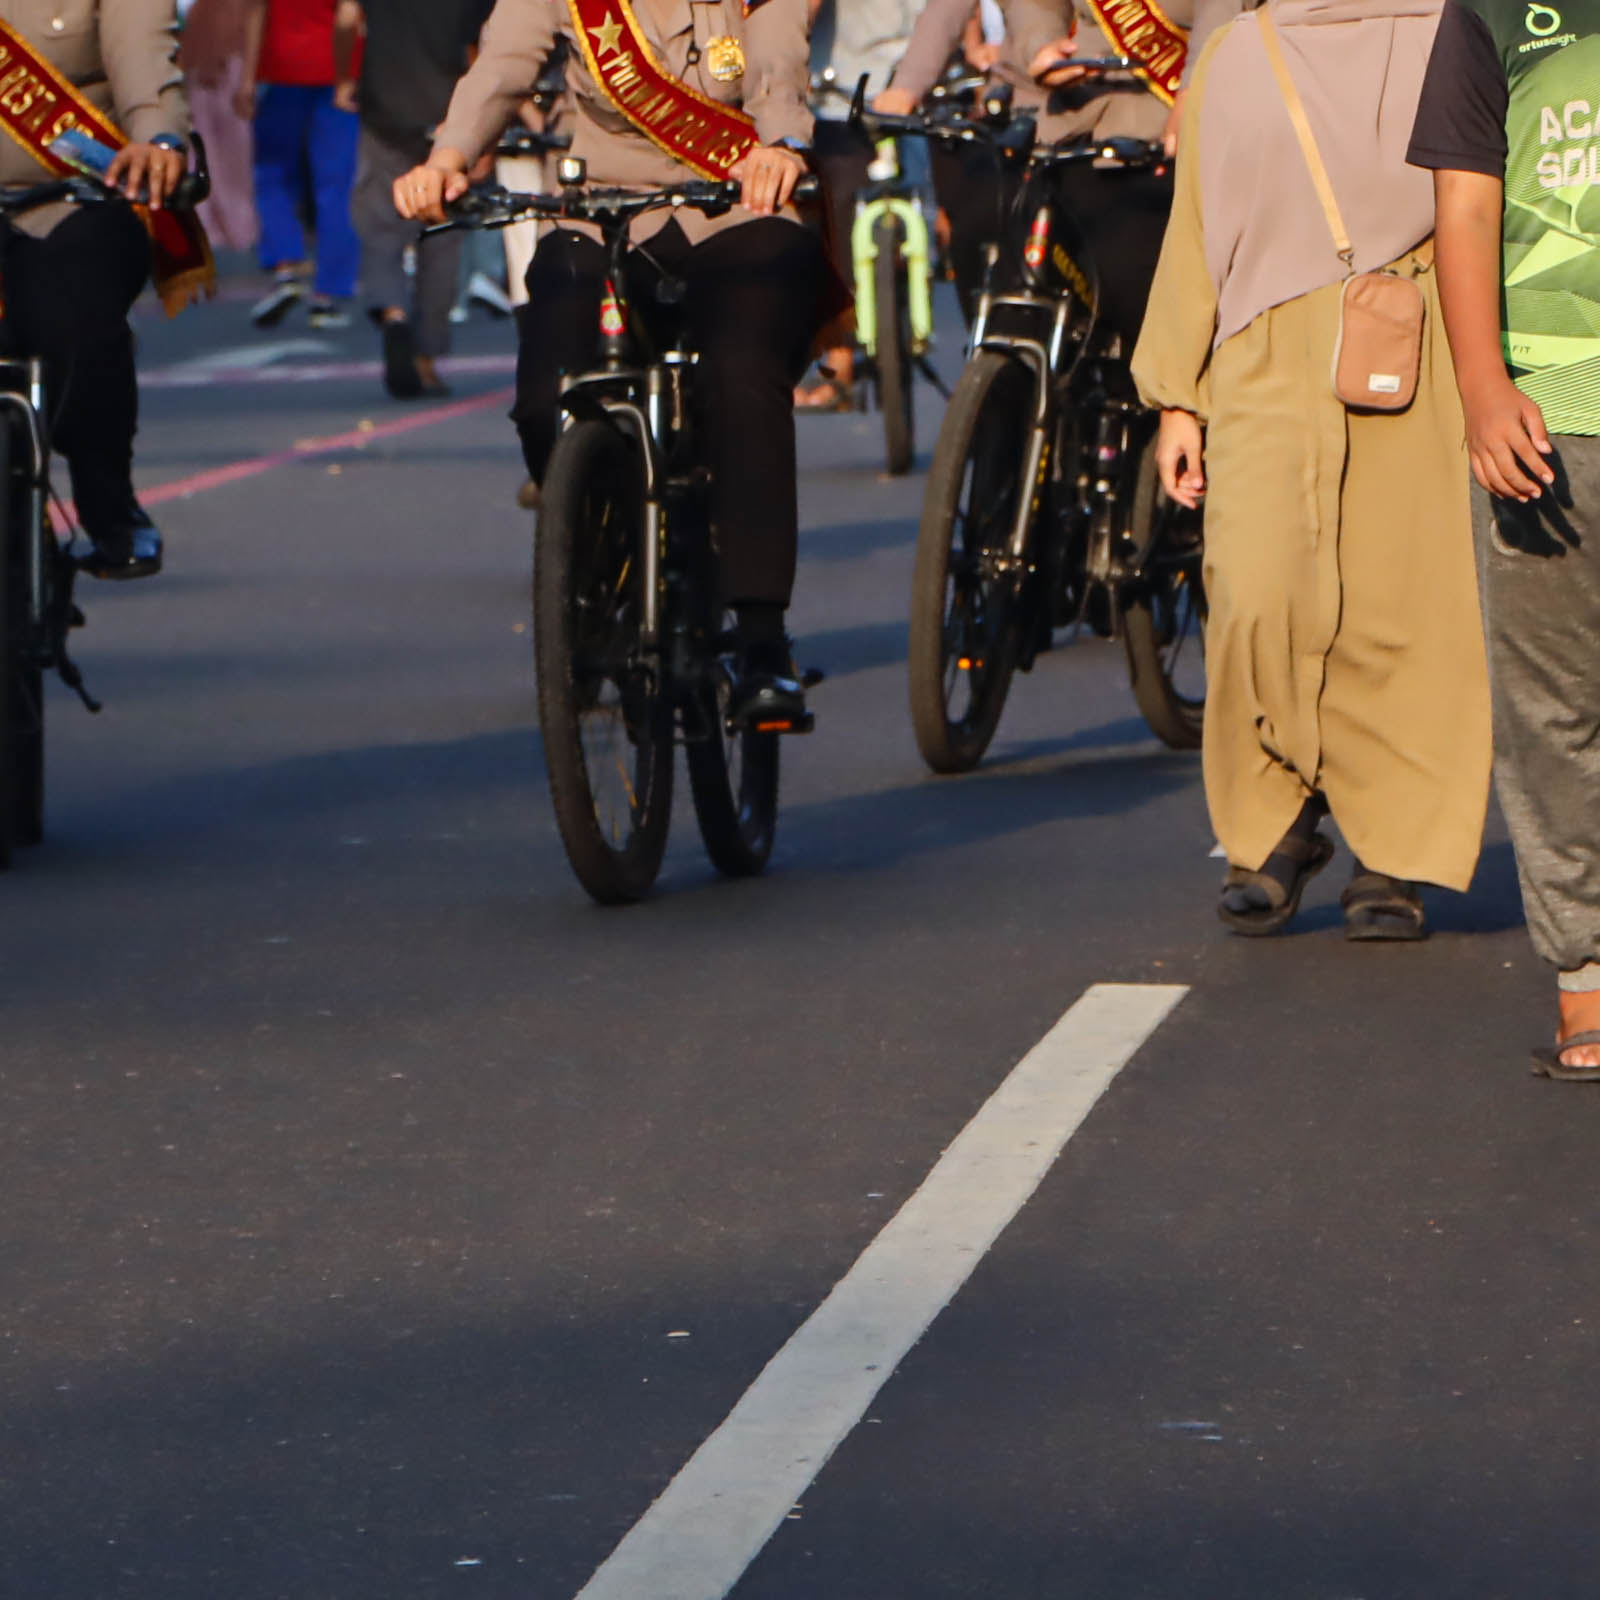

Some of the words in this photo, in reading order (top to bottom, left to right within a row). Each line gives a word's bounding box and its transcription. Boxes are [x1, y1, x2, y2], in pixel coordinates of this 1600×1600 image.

[1518, 33, 1577, 53] ortuseight
[602, 50, 680, 126] POLWAN
[661, 111, 751, 169] POLRES
